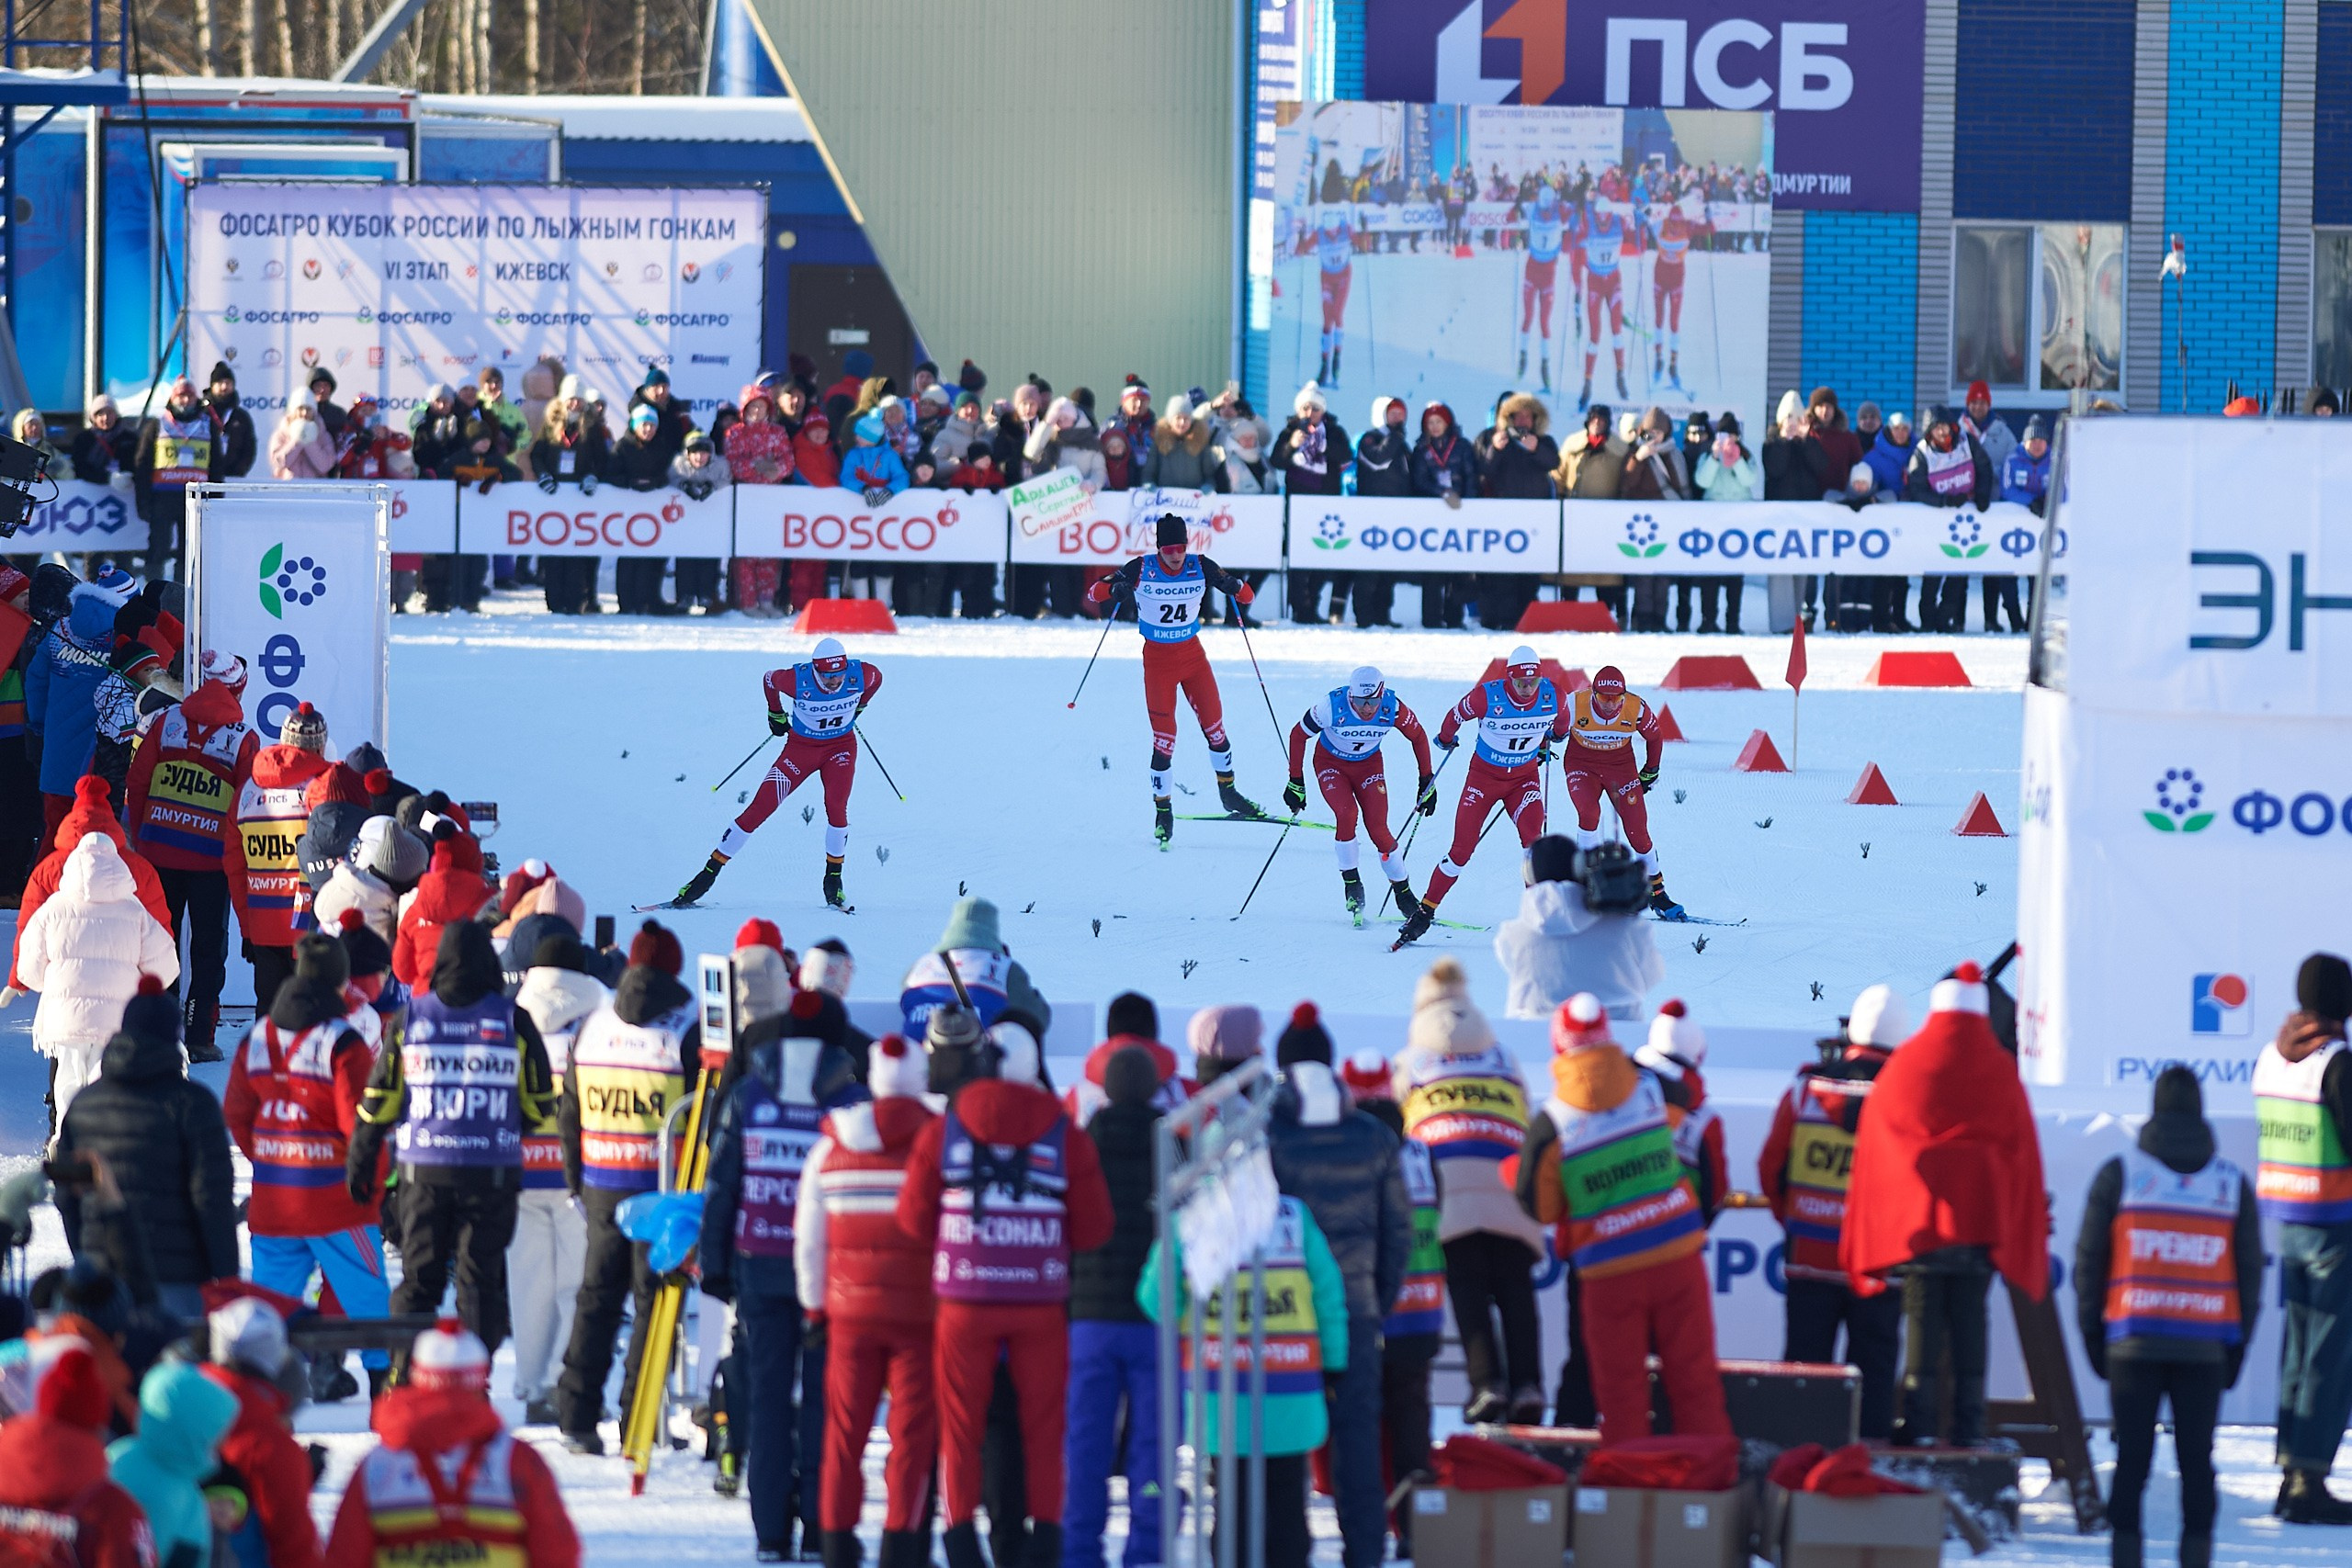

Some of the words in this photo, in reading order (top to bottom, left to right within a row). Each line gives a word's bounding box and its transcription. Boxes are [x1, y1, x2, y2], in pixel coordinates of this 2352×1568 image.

[1605, 17, 1854, 110] ПСБ
[220, 212, 321, 237] ФОСАГРО
[327, 213, 397, 238] КУБОК
[403, 215, 490, 239] РОССИИ
[497, 216, 526, 239] ПО
[531, 217, 642, 241] ЛЫЖНЫМ
[649, 218, 736, 242] ГОНКАМ
[385, 261, 401, 281] VI
[405, 261, 449, 281] ЭТАП
[495, 262, 571, 282] ИЖЕВСК
[243, 310, 320, 324] ФОСАГРО
[377, 310, 452, 325] ФОСАГРО
[515, 312, 592, 327] ФОСАГРО
[654, 313, 730, 328] ФОСАГРО
[507, 510, 662, 547] BOSCO
[784, 513, 937, 552] BOSCO
[1360, 525, 1531, 554] ФОСАГРО
[1678, 526, 1892, 559] ФОСАГРО
[1155, 585, 1202, 596] ФОСАГРО
[1159, 604, 1188, 624] 24
[1153, 626, 1193, 639] ИЖЕВСК
[1598, 679, 1623, 688] LUKOIL
[816, 716, 843, 729] 14
[1351, 741, 1365, 751] 7
[1508, 736, 1533, 751] 17
[161, 763, 222, 797] СУДЬЯ
[268, 795, 288, 805] ПСБ
[151, 806, 219, 833] ДМУРТИЯ
[2232, 789, 2352, 837] ФО
[424, 1053, 515, 1074] ЛУКОЙЛ
[410, 1085, 509, 1122] ЖЮРИ
[587, 1085, 667, 1119] СУДЬЯ
[2127, 1227, 2228, 1267] ТРЕНЕР
